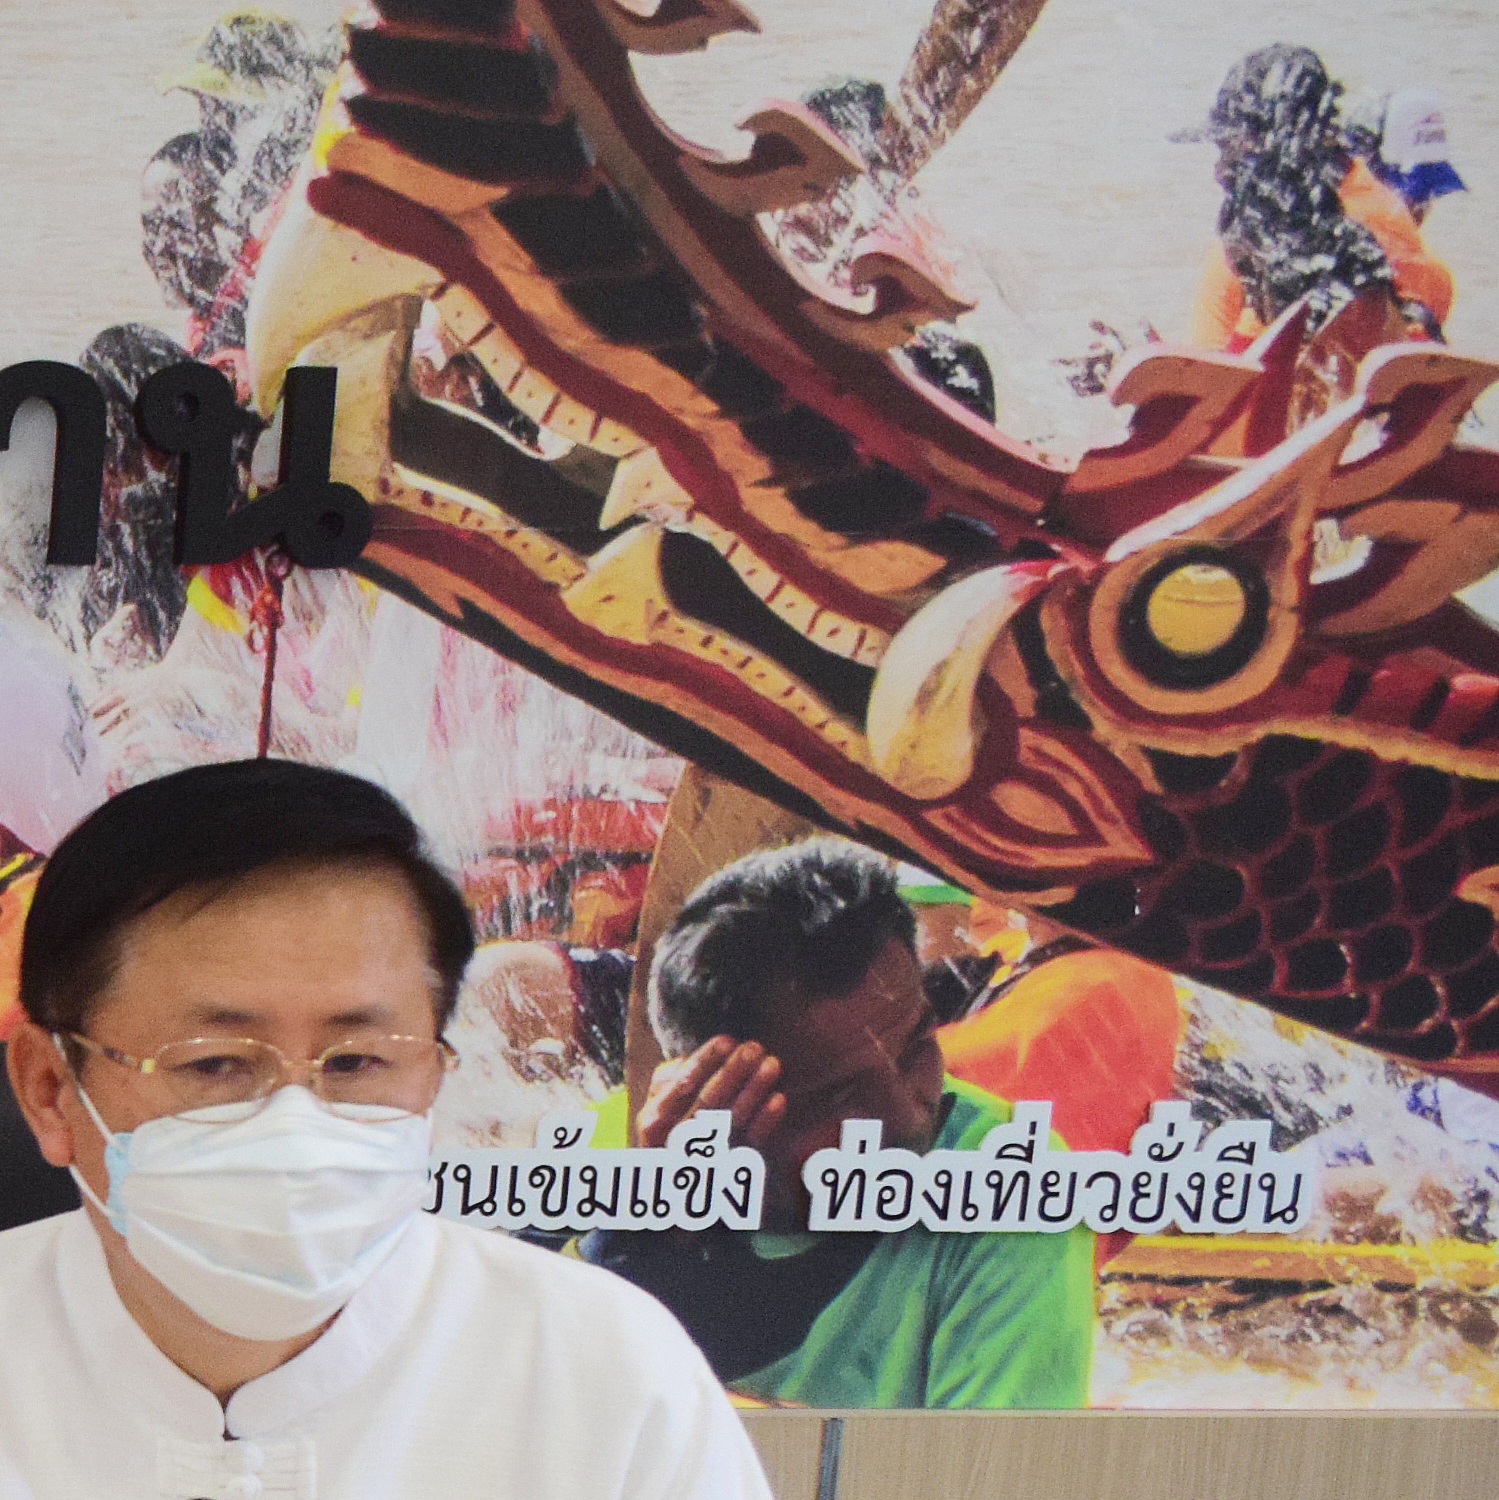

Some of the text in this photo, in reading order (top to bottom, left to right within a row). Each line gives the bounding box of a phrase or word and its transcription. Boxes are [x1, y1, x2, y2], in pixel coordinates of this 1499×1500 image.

[822, 1119, 1304, 1225] ท่องเที่ยวยั่งยืน
